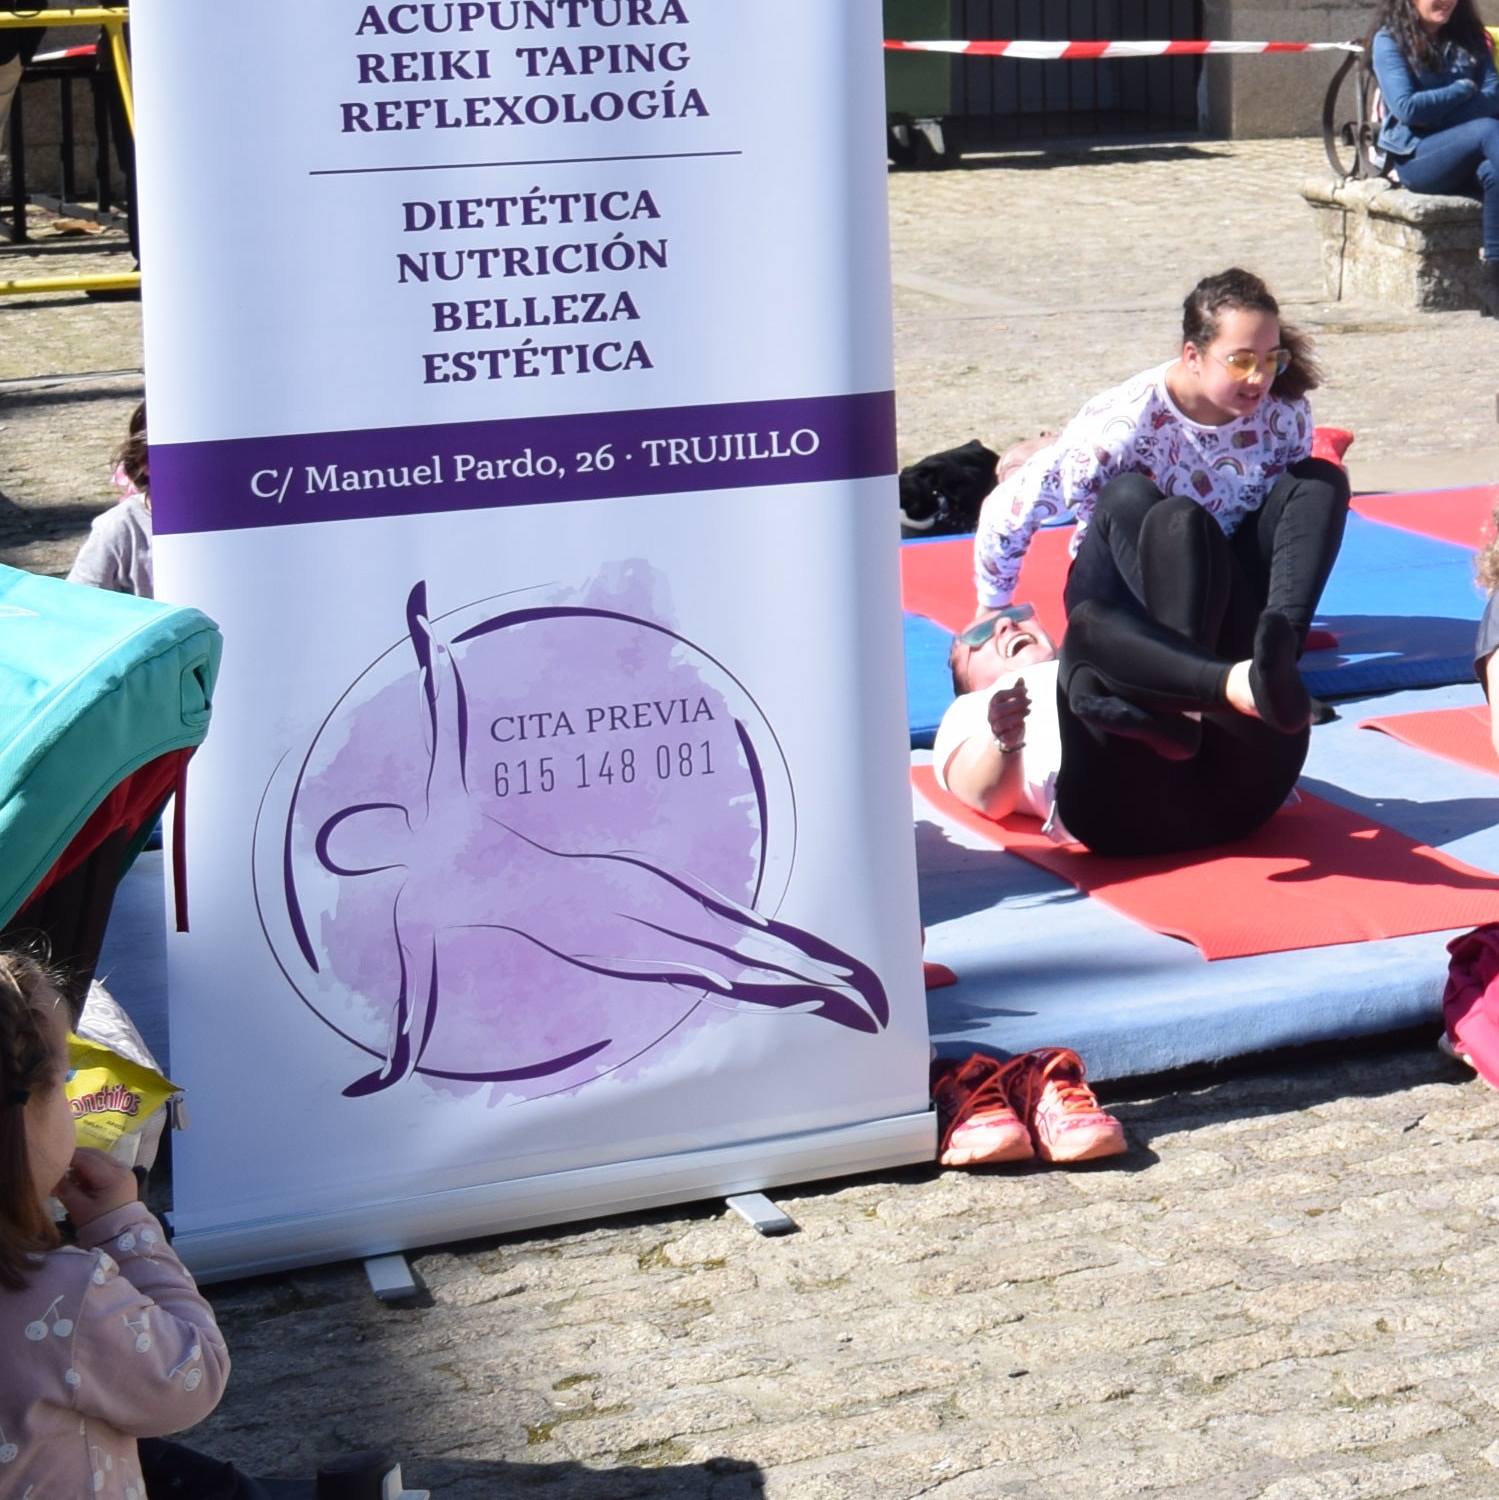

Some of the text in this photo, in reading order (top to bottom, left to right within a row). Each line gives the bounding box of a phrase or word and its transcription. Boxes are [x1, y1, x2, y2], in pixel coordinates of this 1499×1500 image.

[356, 42, 691, 84] REIKI TAPING
[339, 81, 710, 133] REFLEXOLOGÍA
[401, 186, 661, 233] DIETÉTICA
[396, 233, 669, 284] NUTRICIÓN
[431, 291, 641, 333] BELLEZA
[420, 340, 655, 385] ESTÉTICA
[250, 428, 820, 503] C/ Manuel Pardo, 26 TRUJILLO
[490, 696, 716, 743] CITA PREVIA
[494, 740, 716, 798] 615 148 081
[68, 1084, 141, 1118] onchitos
